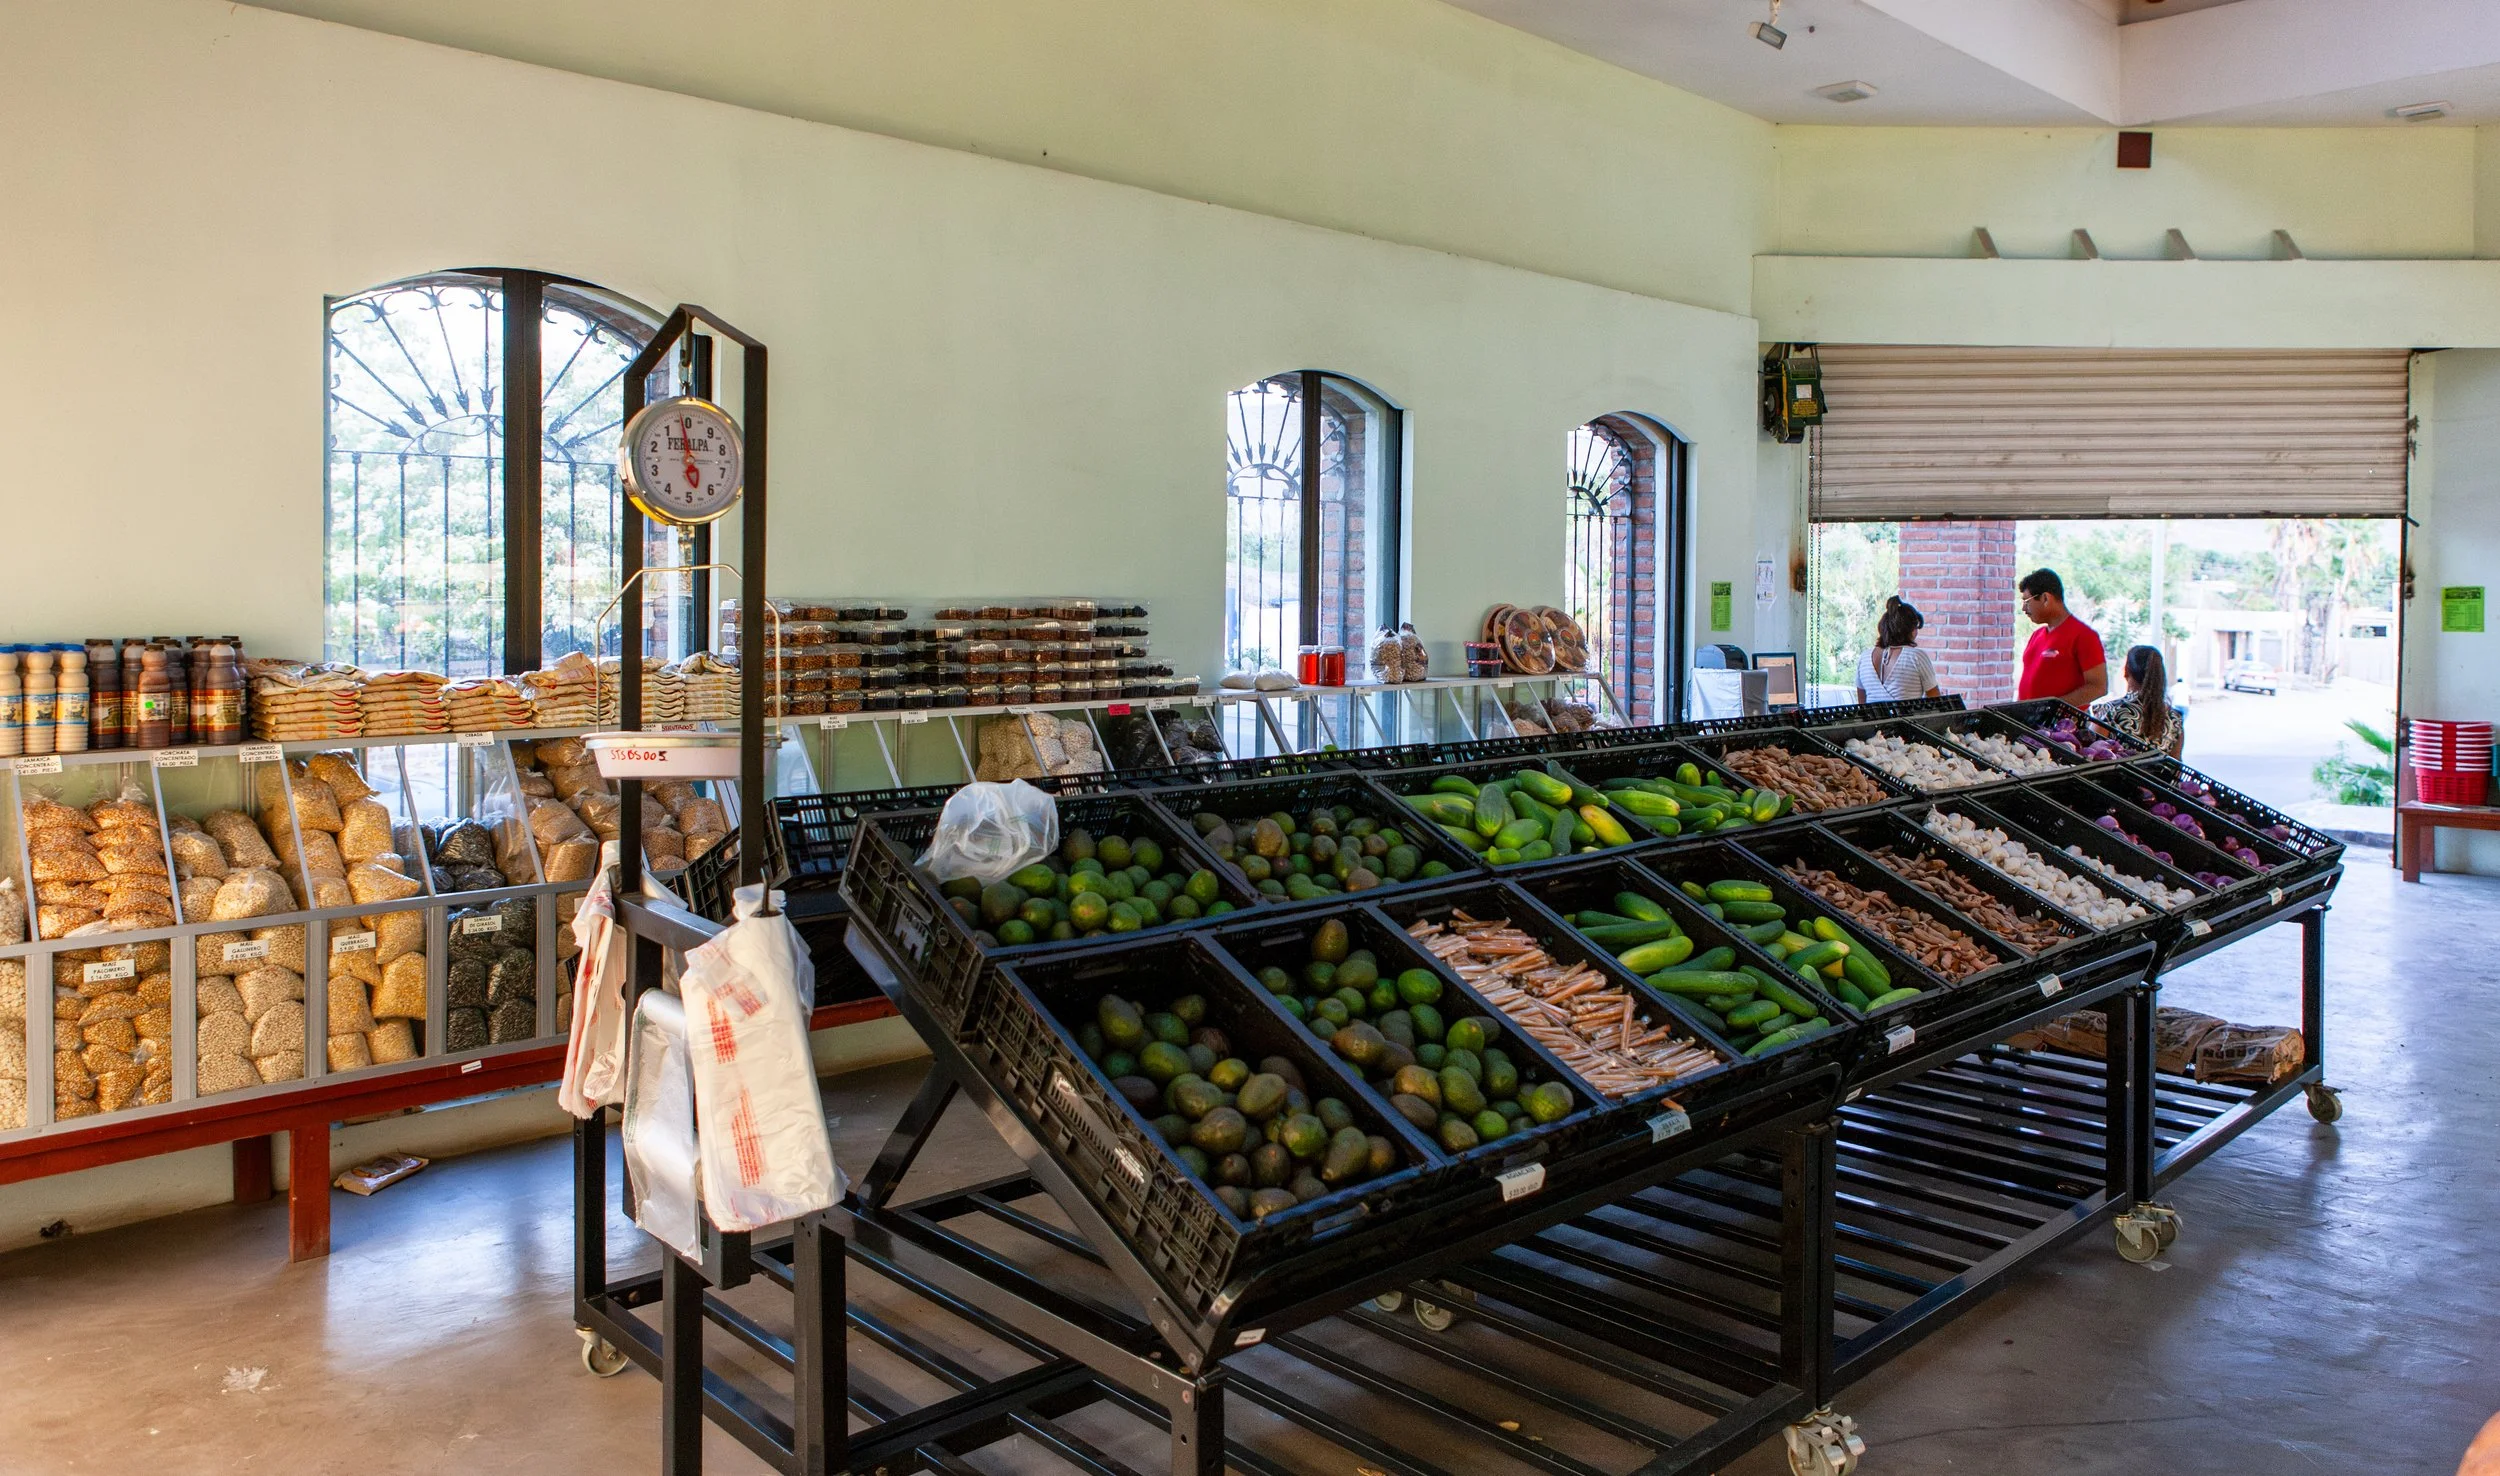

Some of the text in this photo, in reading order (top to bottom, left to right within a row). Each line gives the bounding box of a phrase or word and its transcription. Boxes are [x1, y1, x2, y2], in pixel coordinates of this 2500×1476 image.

[685, 418, 692, 429] 0
[665, 425, 670, 436] 1
[707, 428, 714, 439] 9
[651, 441, 658, 453] 2
[719, 445, 726, 456] 8
[651, 465, 658, 476] 3
[719, 468, 726, 479] 7
[664, 483, 672, 494] 4
[707, 484, 714, 495] 6
[686, 492, 693, 503] 5
[341, 938, 368, 946] QUEBRADO
